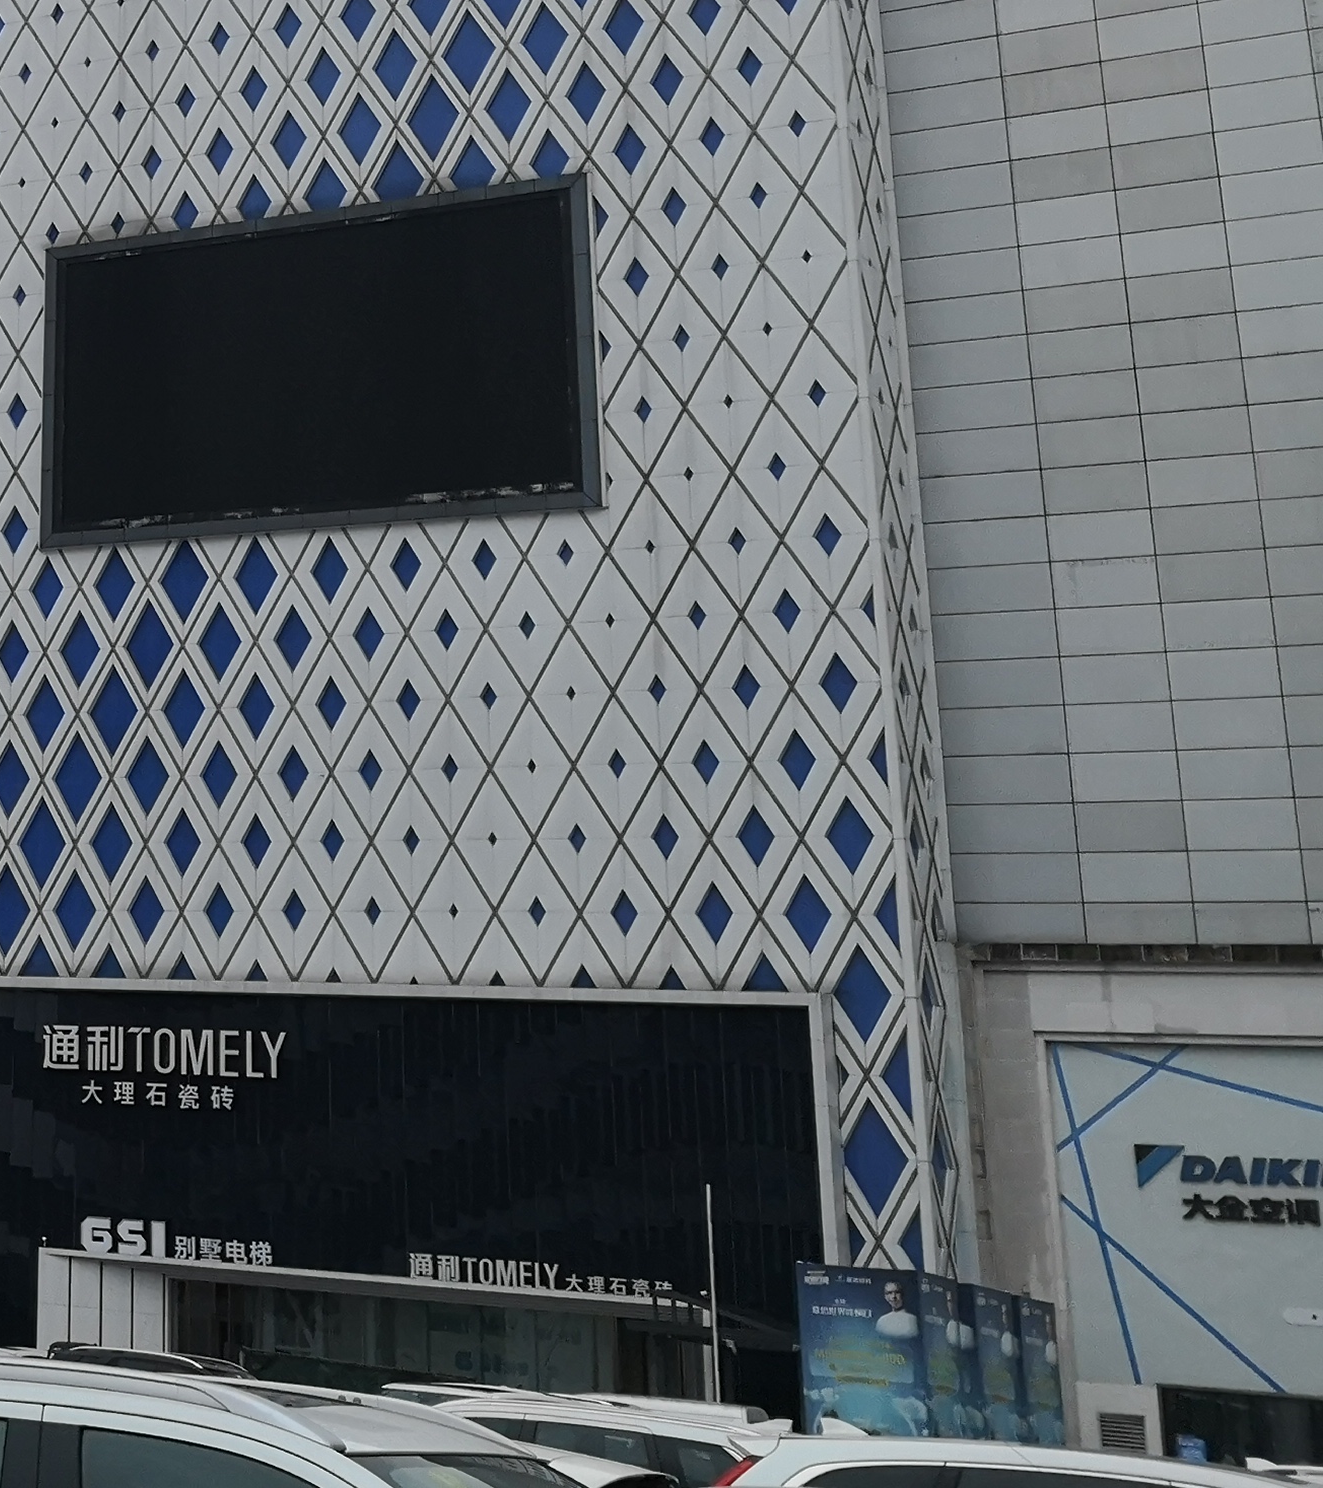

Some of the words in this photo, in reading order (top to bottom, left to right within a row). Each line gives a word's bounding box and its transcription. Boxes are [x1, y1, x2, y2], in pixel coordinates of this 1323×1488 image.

[43, 1024, 287, 1079] 通利TOMELY
[81, 1080, 235, 1111] 大理石瓷砖
[1180, 1154, 1323, 1187] DAIKI
[173, 1235, 274, 1267] 别墅电梯
